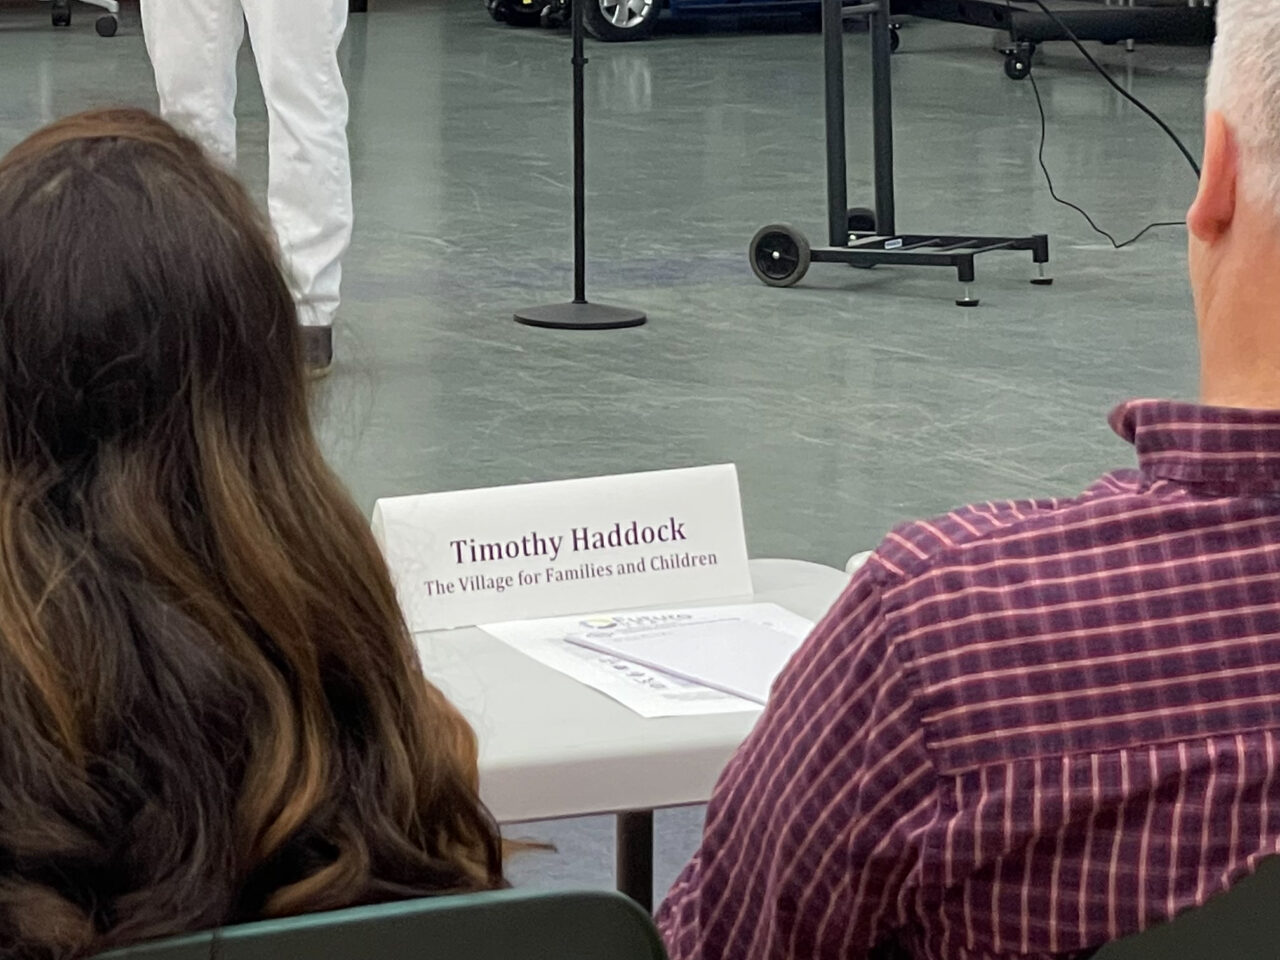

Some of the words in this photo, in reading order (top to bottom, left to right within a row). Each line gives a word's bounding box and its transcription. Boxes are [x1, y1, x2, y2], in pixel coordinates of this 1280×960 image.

[450, 531, 563, 564] Timothy
[570, 517, 687, 552] Haddock
[424, 580, 455, 596] The
[458, 574, 514, 593] Village
[518, 570, 542, 587] for
[545, 563, 613, 583] Families
[617, 557, 646, 575] and
[650, 551, 718, 572] Children
